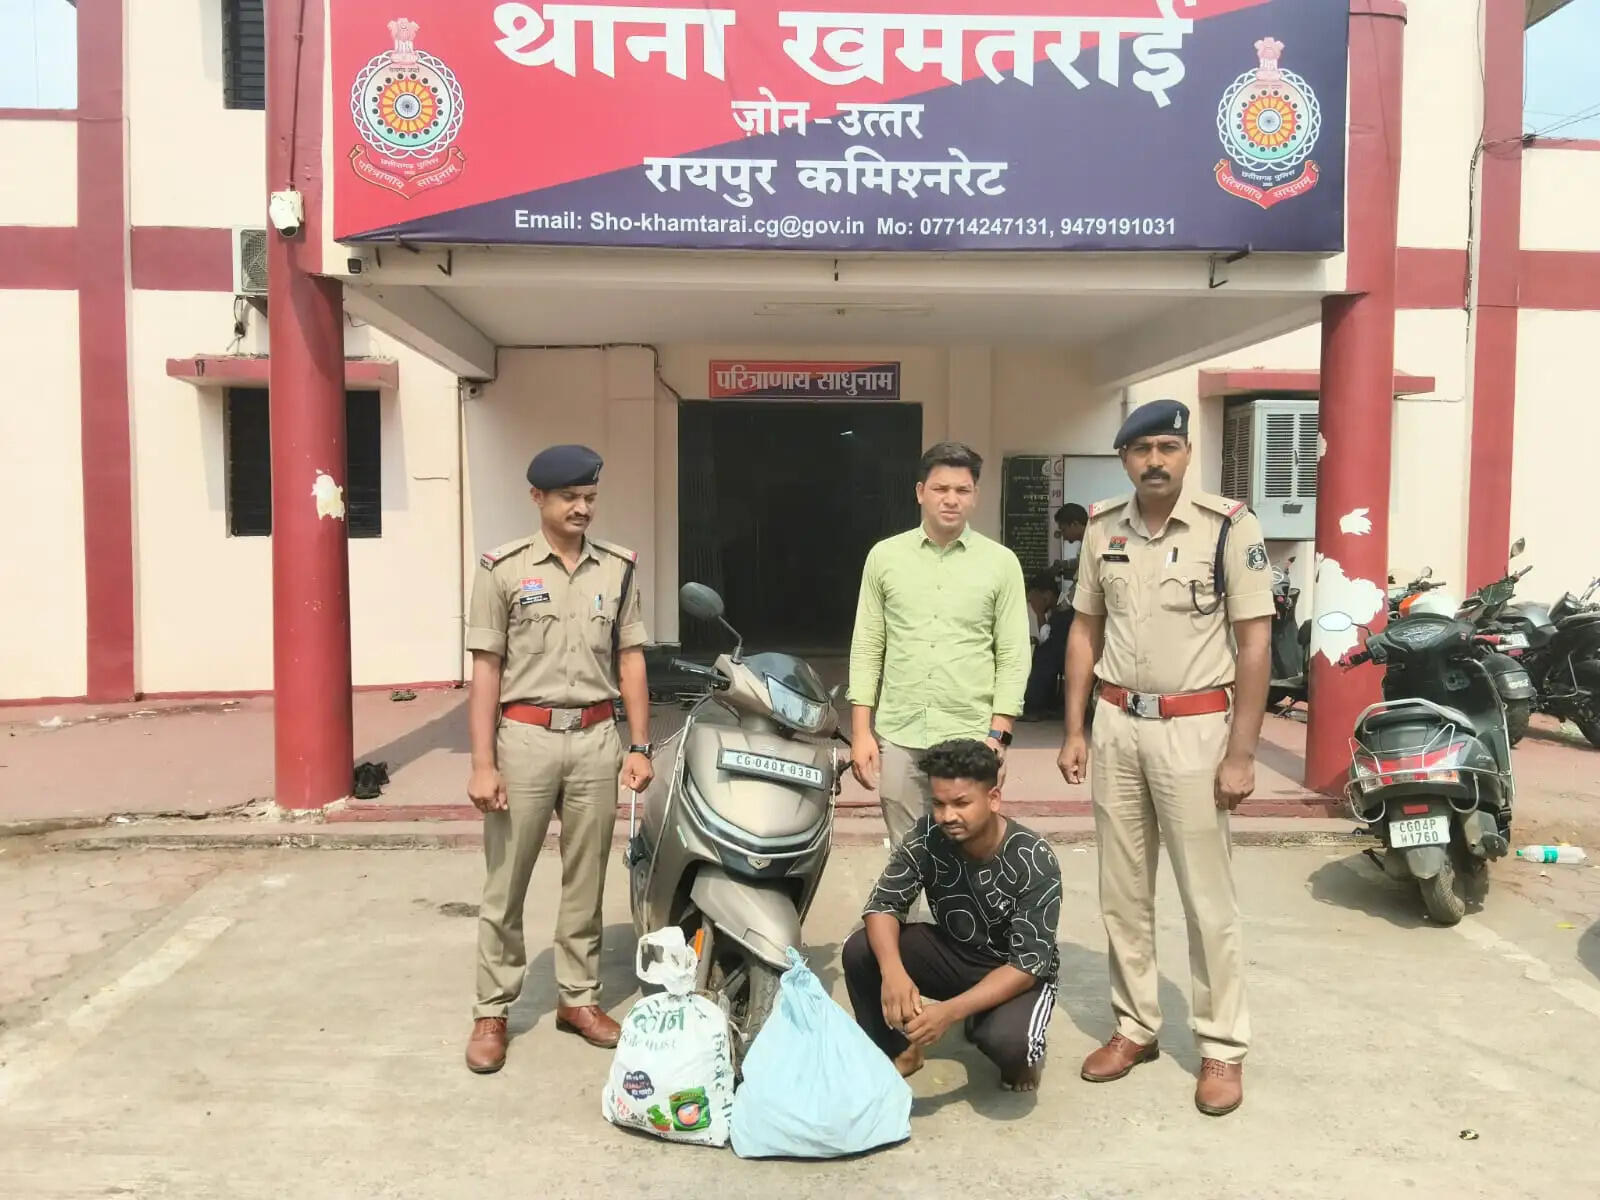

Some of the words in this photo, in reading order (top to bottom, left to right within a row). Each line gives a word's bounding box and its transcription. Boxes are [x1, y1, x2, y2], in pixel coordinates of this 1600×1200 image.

[493, 2, 735, 81] थाना
[779, 0, 1196, 108] खमतराई
[643, 157, 777, 207] रायपुर
[796, 146, 1008, 198] कमिश्नरेट
[514, 209, 582, 230] Email:
[590, 212, 865, 239] Sho-khamtarai.cg@gov.in
[877, 217, 913, 235] Mo:
[920, 218, 1054, 238] 07714247131,
[1060, 218, 1176, 236] 9479191031
[716, 364, 811, 391] परित्राणाय
[1400, 818, 1436, 833] CG04P
